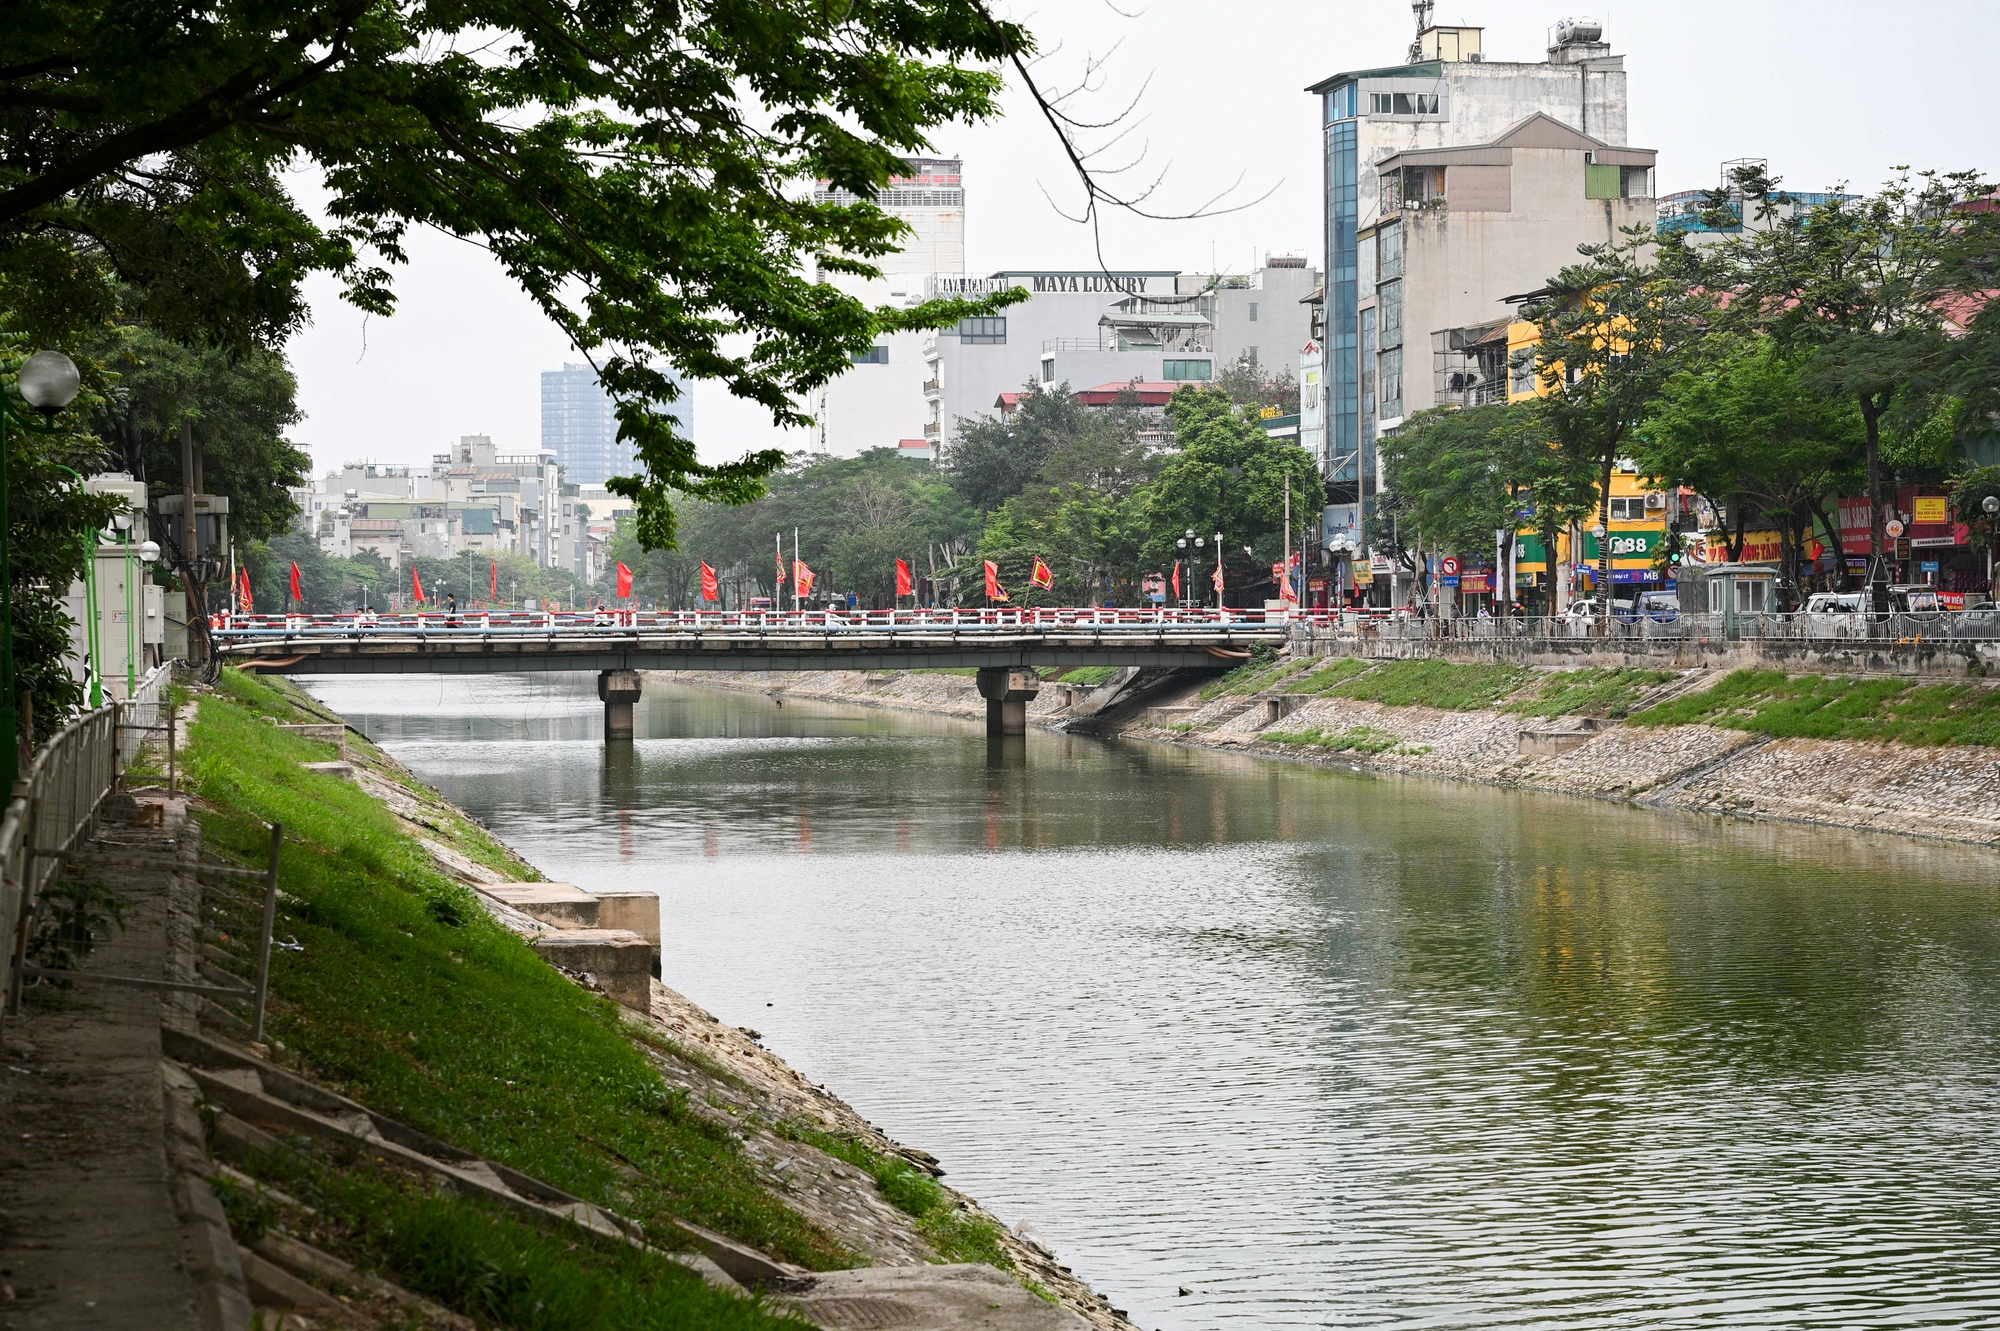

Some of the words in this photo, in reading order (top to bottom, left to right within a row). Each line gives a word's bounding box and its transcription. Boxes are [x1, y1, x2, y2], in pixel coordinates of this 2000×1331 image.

[937, 278, 962, 293] MAYA
[964, 278, 1007, 294] ACADEMY
[1033, 276, 1079, 293] MAYA
[1083, 277, 1148, 293] LUXURY
[1839, 503, 1853, 529] NHÀ
[1852, 502, 1868, 528] SÁCH
[1643, 572, 1659, 581] MB
